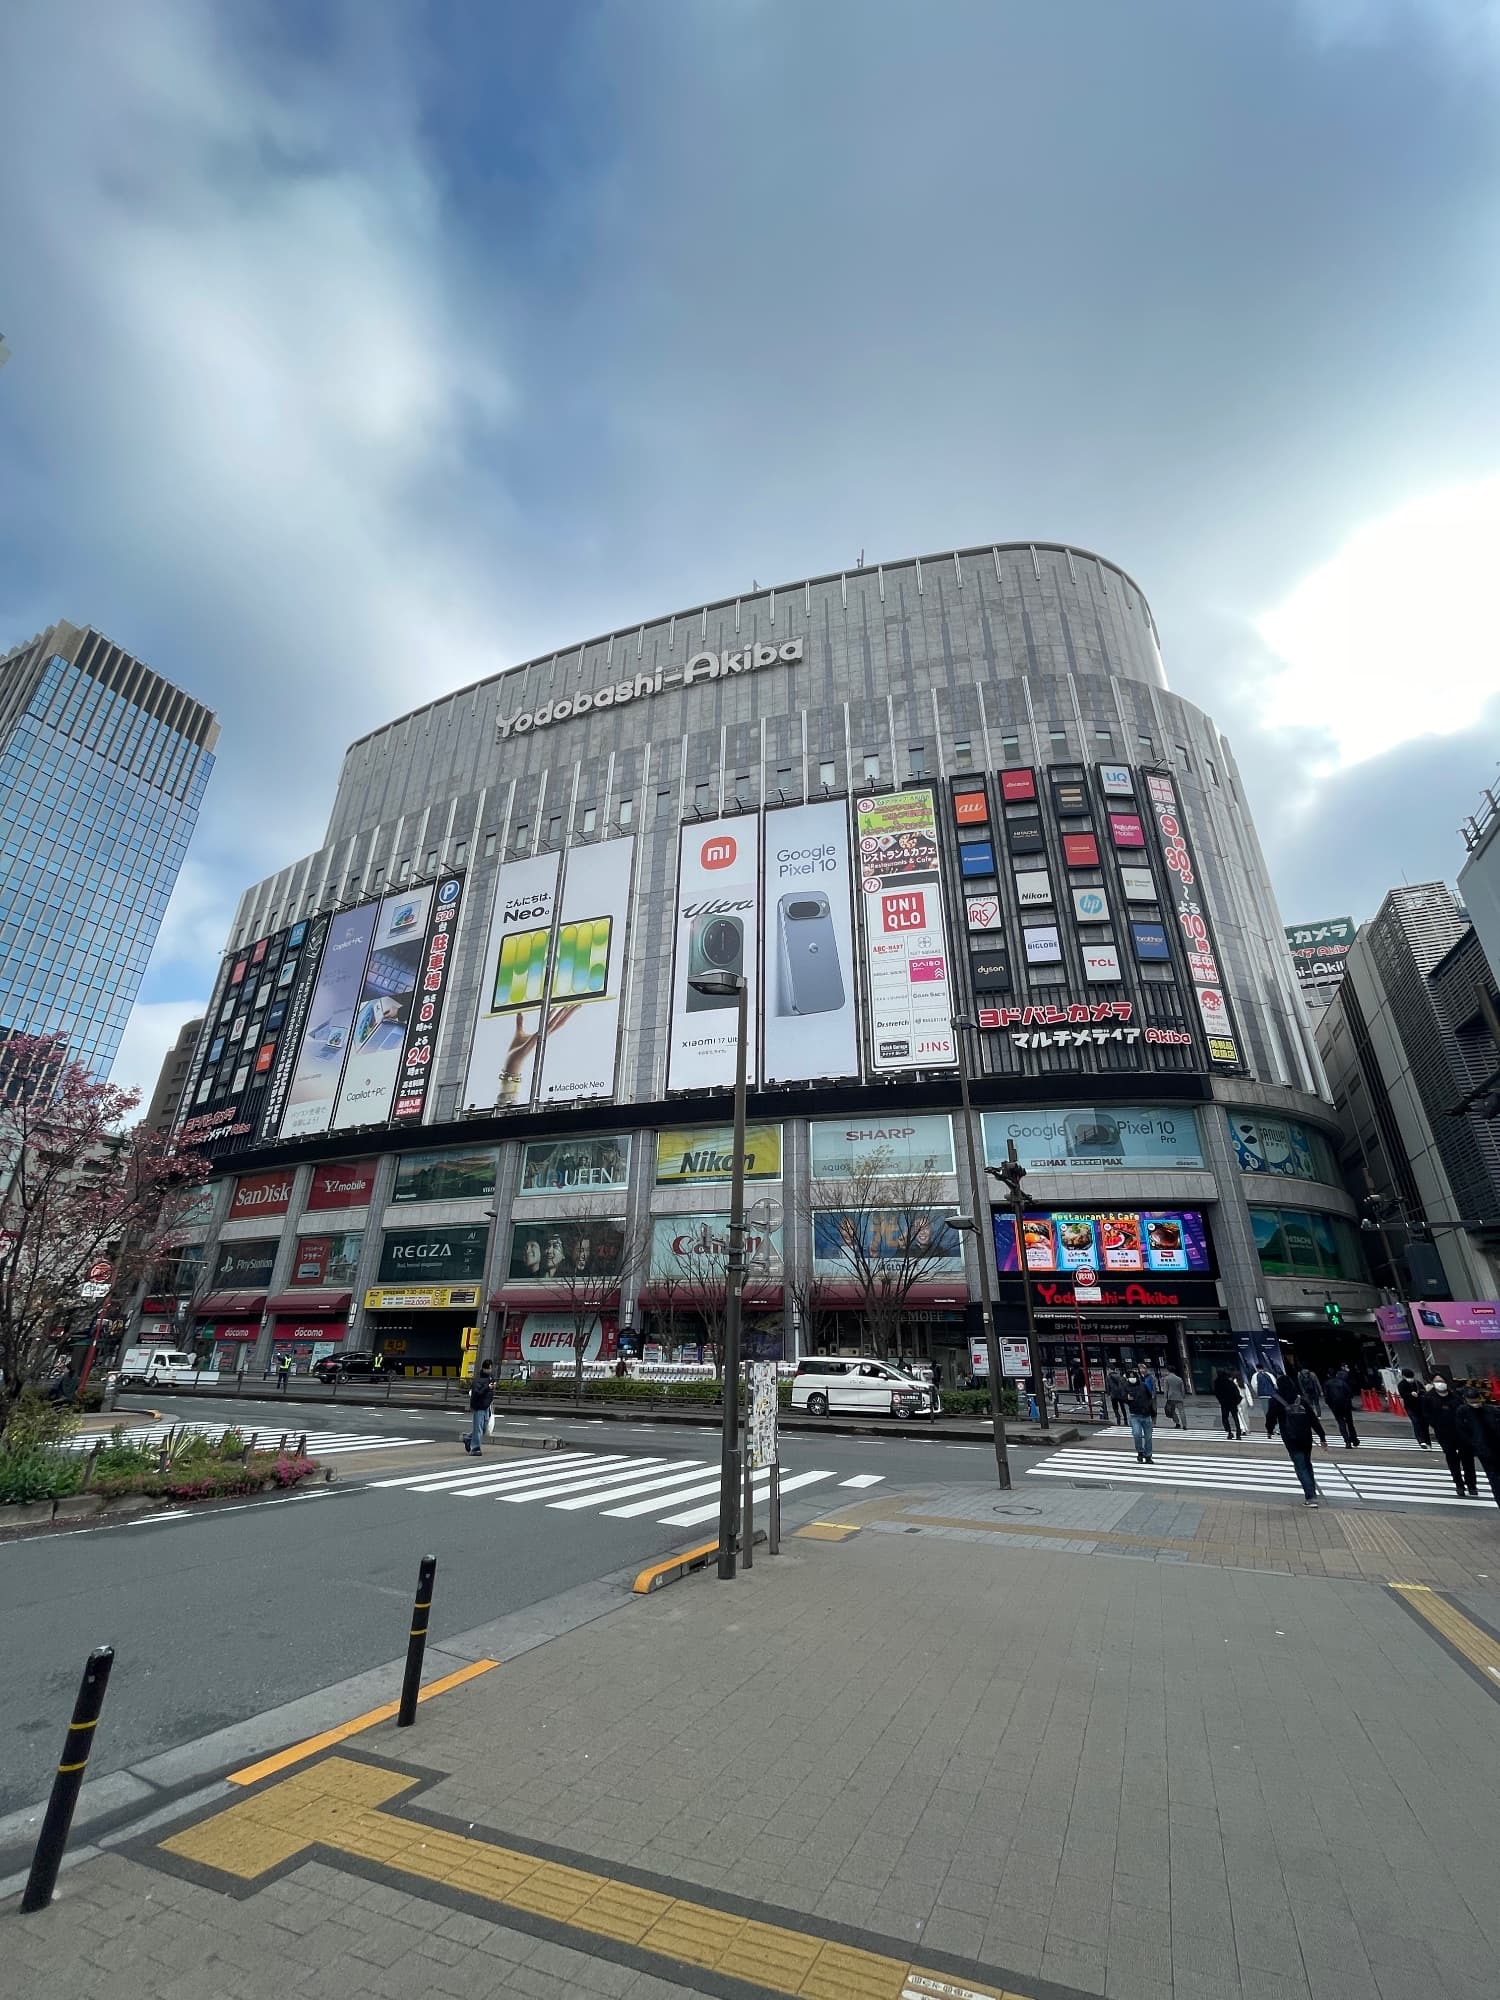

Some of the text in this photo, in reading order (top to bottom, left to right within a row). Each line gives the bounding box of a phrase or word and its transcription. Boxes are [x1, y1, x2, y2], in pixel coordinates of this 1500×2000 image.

[496, 637, 803, 738] Yodobashi-Akiba
[1106, 772, 1127, 783] UQ
[958, 803, 983, 813] au
[1154, 802, 1176, 815] あさ
[1113, 824, 1140, 832] Rakuten
[776, 843, 836, 864] Google
[863, 846, 935, 863] レストラン&カフェ
[779, 858, 837, 878] Pixel 10
[505, 893, 552, 909] こんにちは、
[887, 897, 917, 912] UNI
[1179, 901, 1200, 914] よる
[435, 909, 455, 922] 520
[682, 900, 754, 919] Ultra
[969, 909, 989, 923] IRIS
[888, 912, 920, 929] QLO
[1027, 942, 1057, 950] BIGLOBE
[424, 932, 449, 991] 駐車場
[977, 965, 1004, 975] dyson
[420, 1002, 434, 1021] 8
[978, 1001, 1132, 1028] ヨドバシカメラ
[682, 1038, 716, 1048] xiaomi
[1011, 1028, 1191, 1049] マルチメディア Akiba
[406, 1044, 430, 1066] 24
[555, 1080, 605, 1092] MacBook Neo
[845, 1128, 916, 1141] SHARP
[1007, 1120, 1174, 1140] Google Pixel 10
[1161, 1135, 1177, 1144] Pro
[324, 1179, 367, 1192] Y!mobile
[236, 1182, 292, 1206] SanDisk
[1051, 1213, 1106, 1221] Restaurant
[1117, 1213, 1140, 1221] Cafe
[392, 1243, 452, 1259] REGZA
[224, 1327, 249, 1337] docomo
[294, 1326, 323, 1337] docomo
